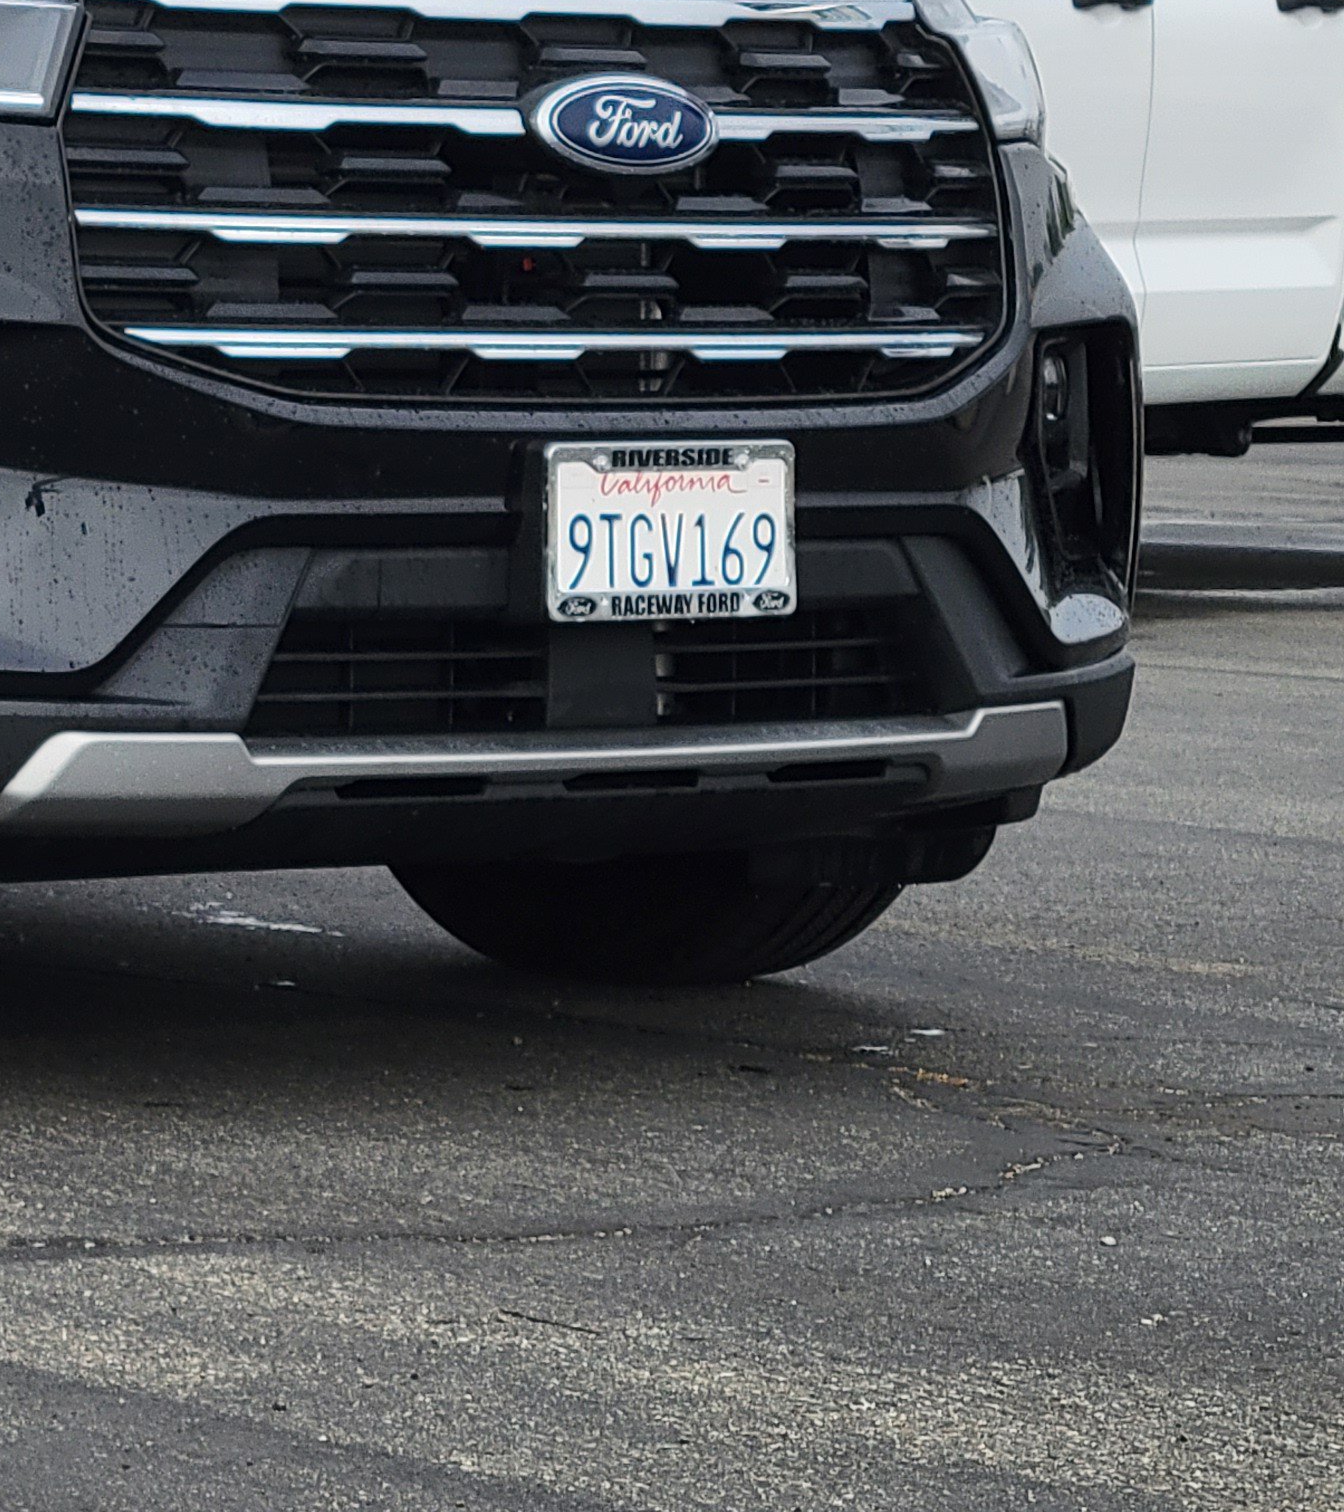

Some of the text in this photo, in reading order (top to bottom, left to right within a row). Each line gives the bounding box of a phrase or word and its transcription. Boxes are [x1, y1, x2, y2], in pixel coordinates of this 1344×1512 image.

[588, 95, 683, 148] Ford
[612, 448, 733, 467] RIVERSIDE
[569, 512, 776, 589] 9TGV169
[612, 594, 692, 616] RACEWAY
[697, 592, 740, 613] FORD
